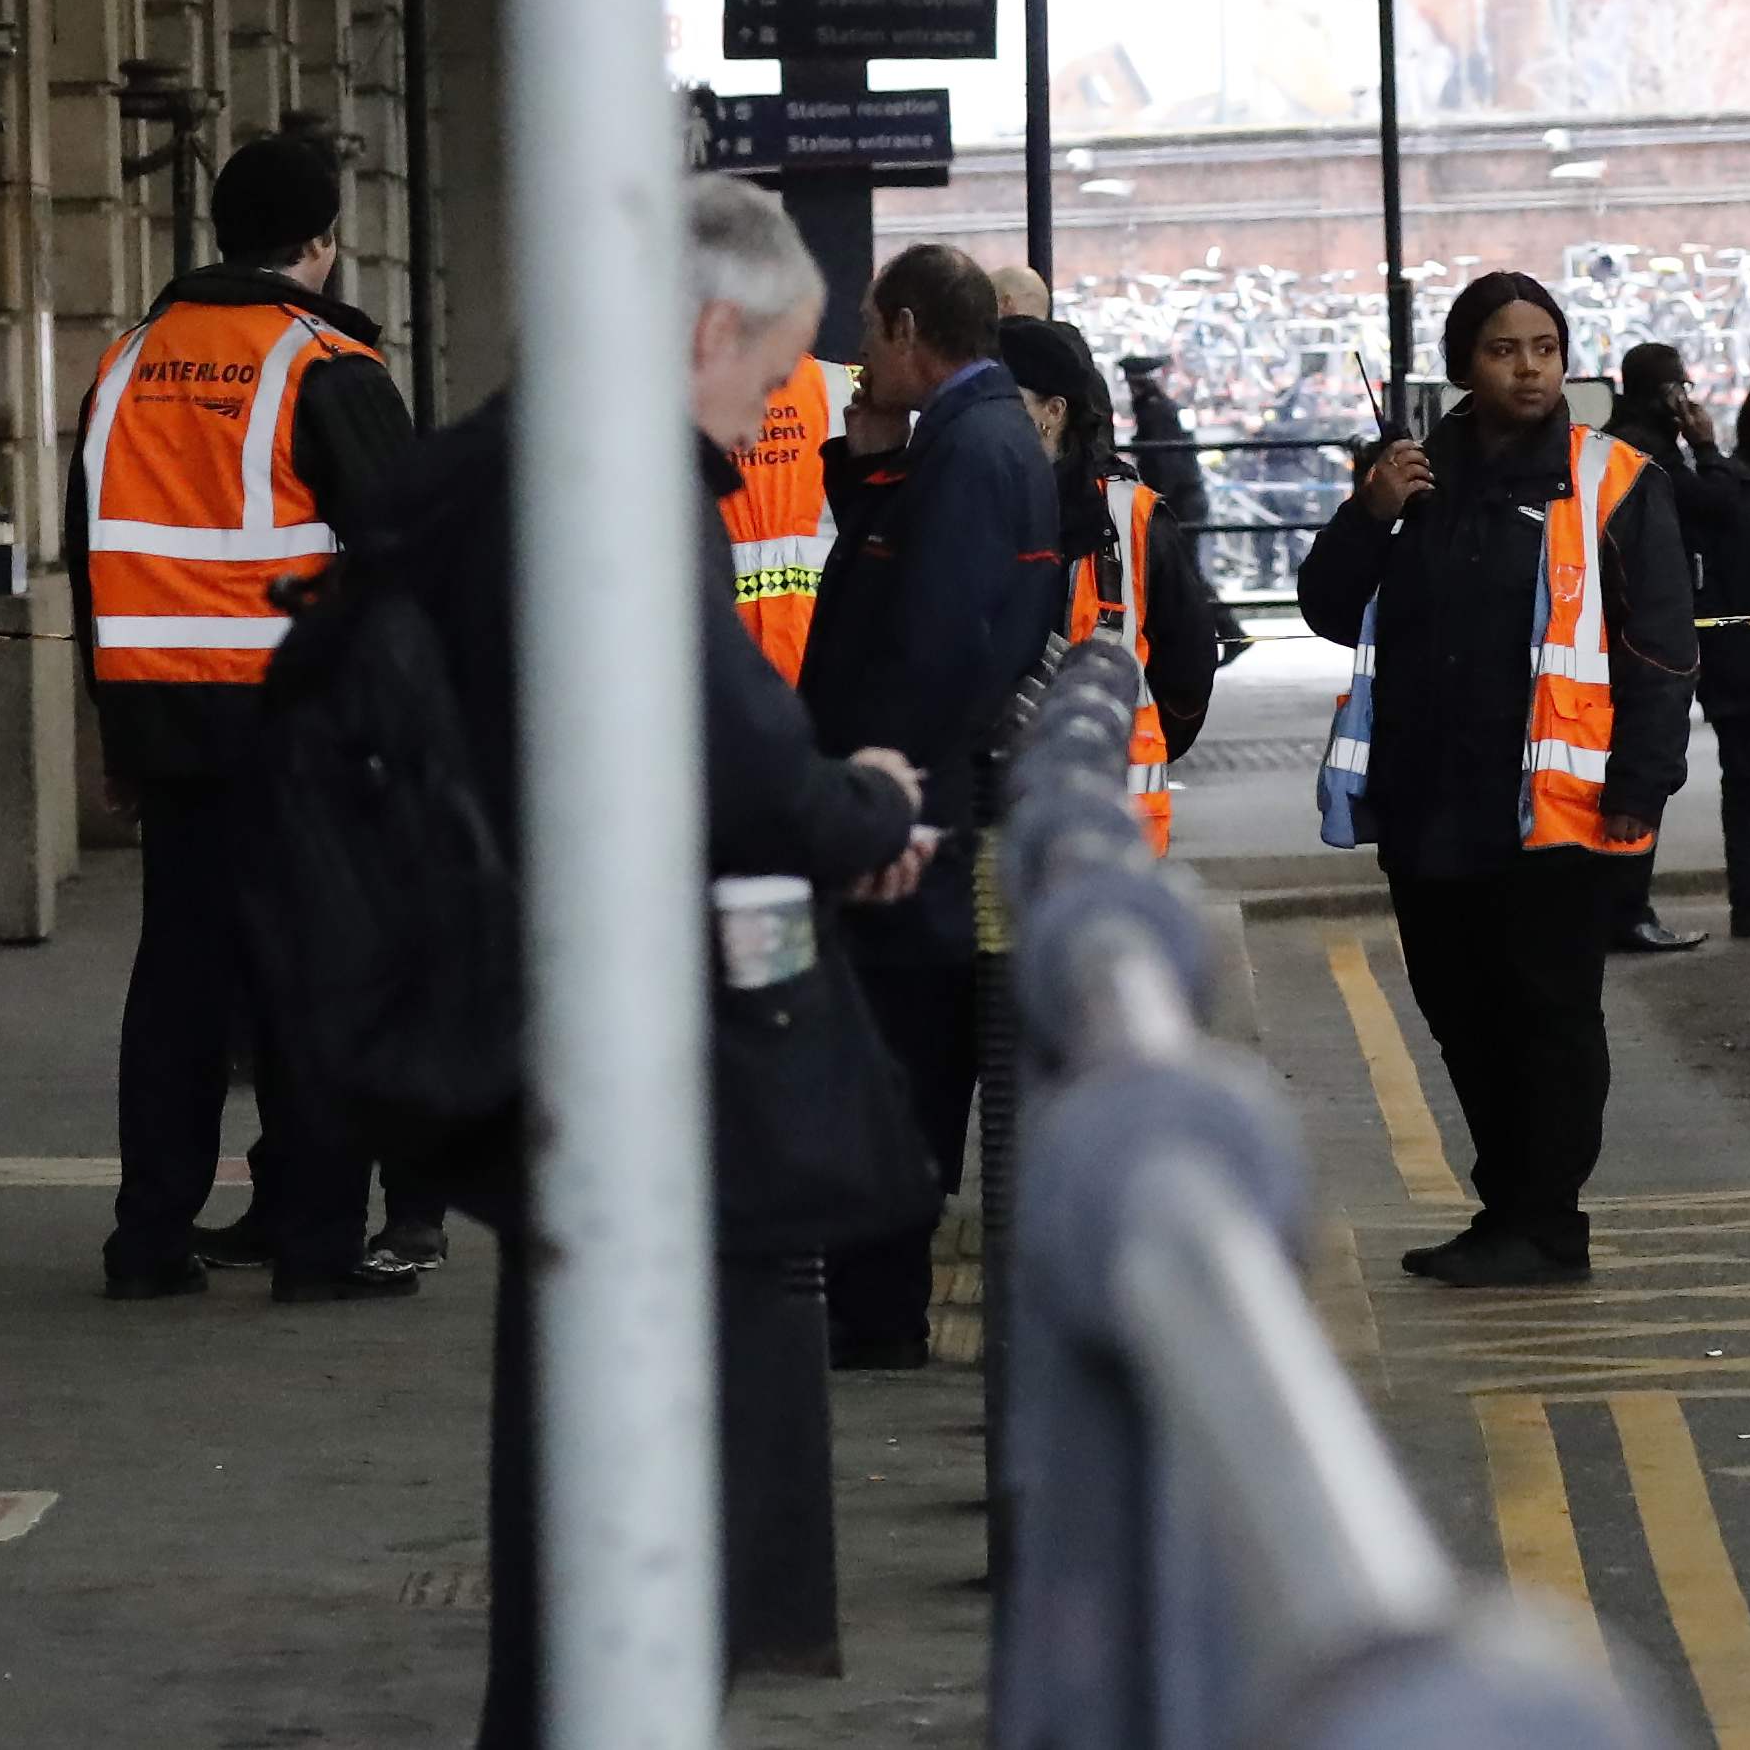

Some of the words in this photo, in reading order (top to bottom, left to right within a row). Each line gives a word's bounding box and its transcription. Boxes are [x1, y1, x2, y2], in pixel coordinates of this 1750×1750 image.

[786, 102, 852, 120] Station
[786, 135, 852, 152] Station
[138, 361, 254, 384] WATERLOO
